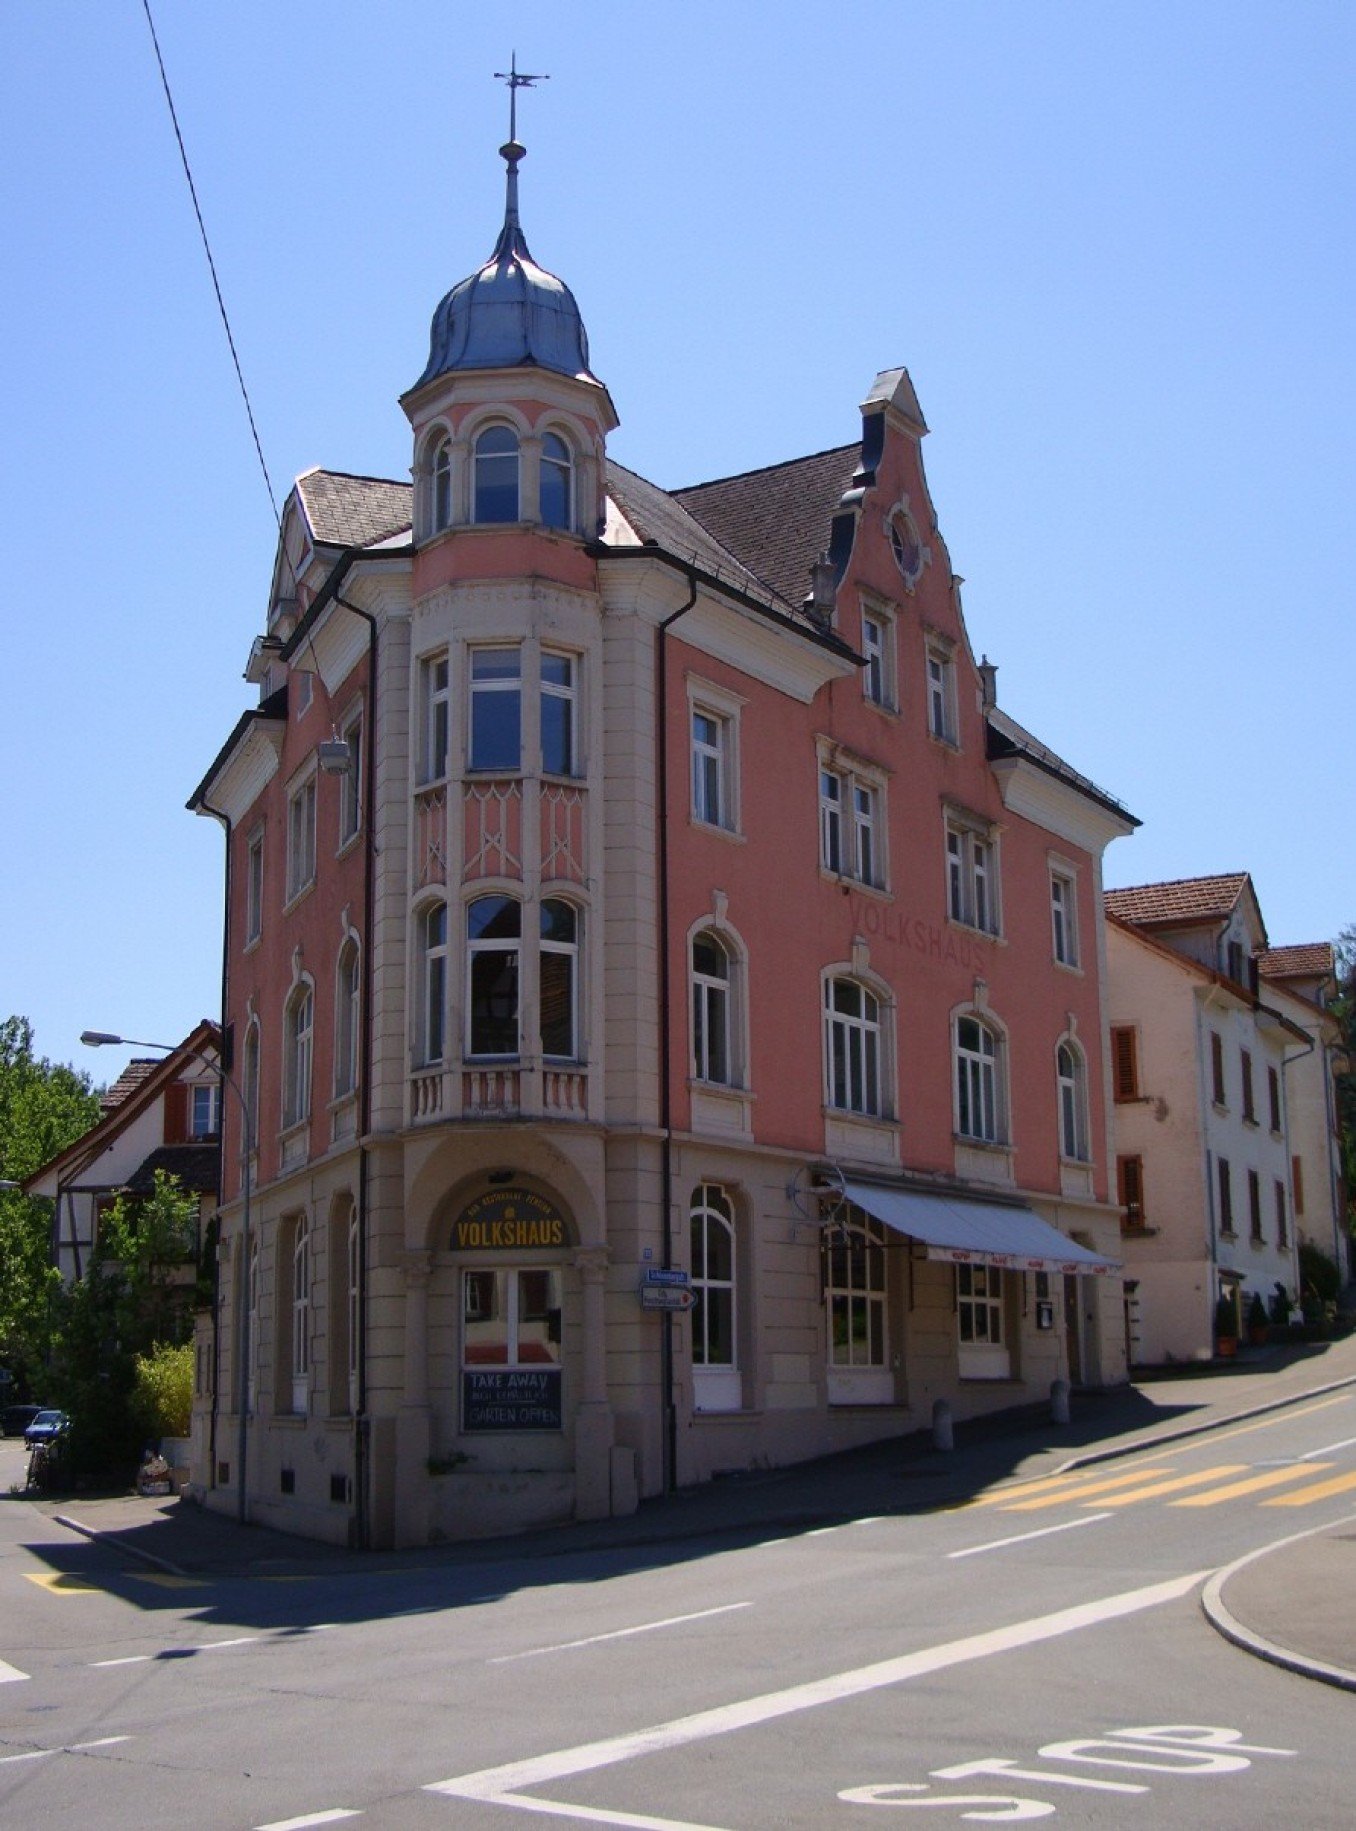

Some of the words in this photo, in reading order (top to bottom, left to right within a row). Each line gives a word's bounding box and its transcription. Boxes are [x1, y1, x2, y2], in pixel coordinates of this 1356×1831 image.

[850, 900, 985, 972] VOLKSHAUS
[458, 1219, 562, 1246] VOLKSHAUS
[471, 1374, 502, 1387] TAKE
[508, 1373, 547, 1390] AWAY
[469, 1407, 516, 1423] GARTEN
[520, 1407, 560, 1423] OFFEN
[837, 1724, 1300, 1821] STOP
